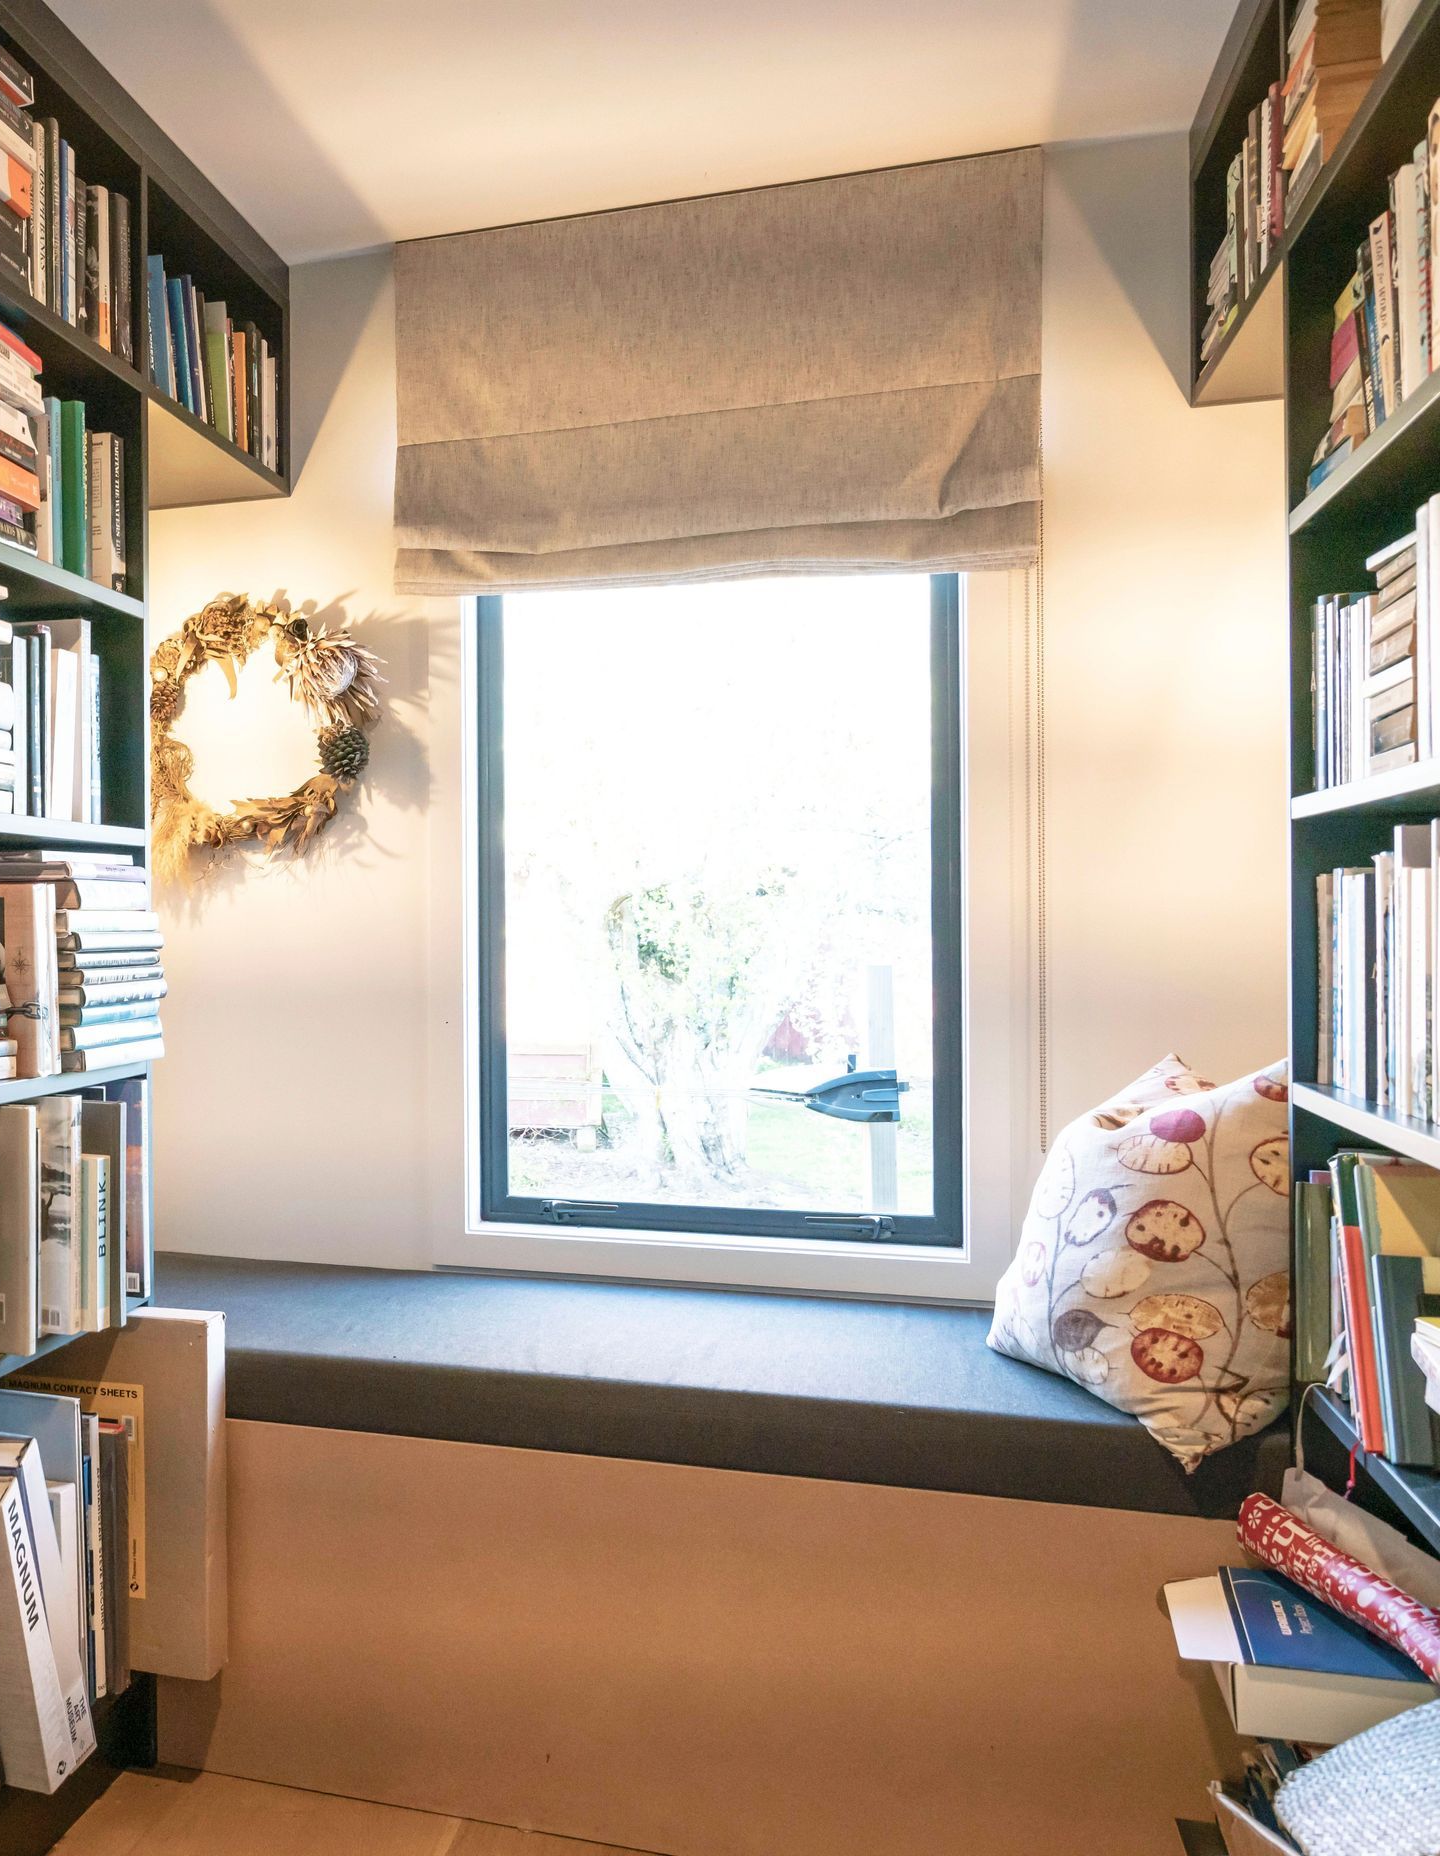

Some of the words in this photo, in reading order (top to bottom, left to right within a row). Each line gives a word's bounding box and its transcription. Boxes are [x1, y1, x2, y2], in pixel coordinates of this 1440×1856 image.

[9, 1380, 51, 1392] MAGNUM
[53, 1382, 97, 1396] CONTACT
[101, 1386, 138, 1399] SHEETS
[8, 1499, 39, 1632] MAGNUM
[74, 1704, 82, 1723] ART
[79, 1697, 87, 1718] THE
[65, 1697, 78, 1744] MUSEUM
